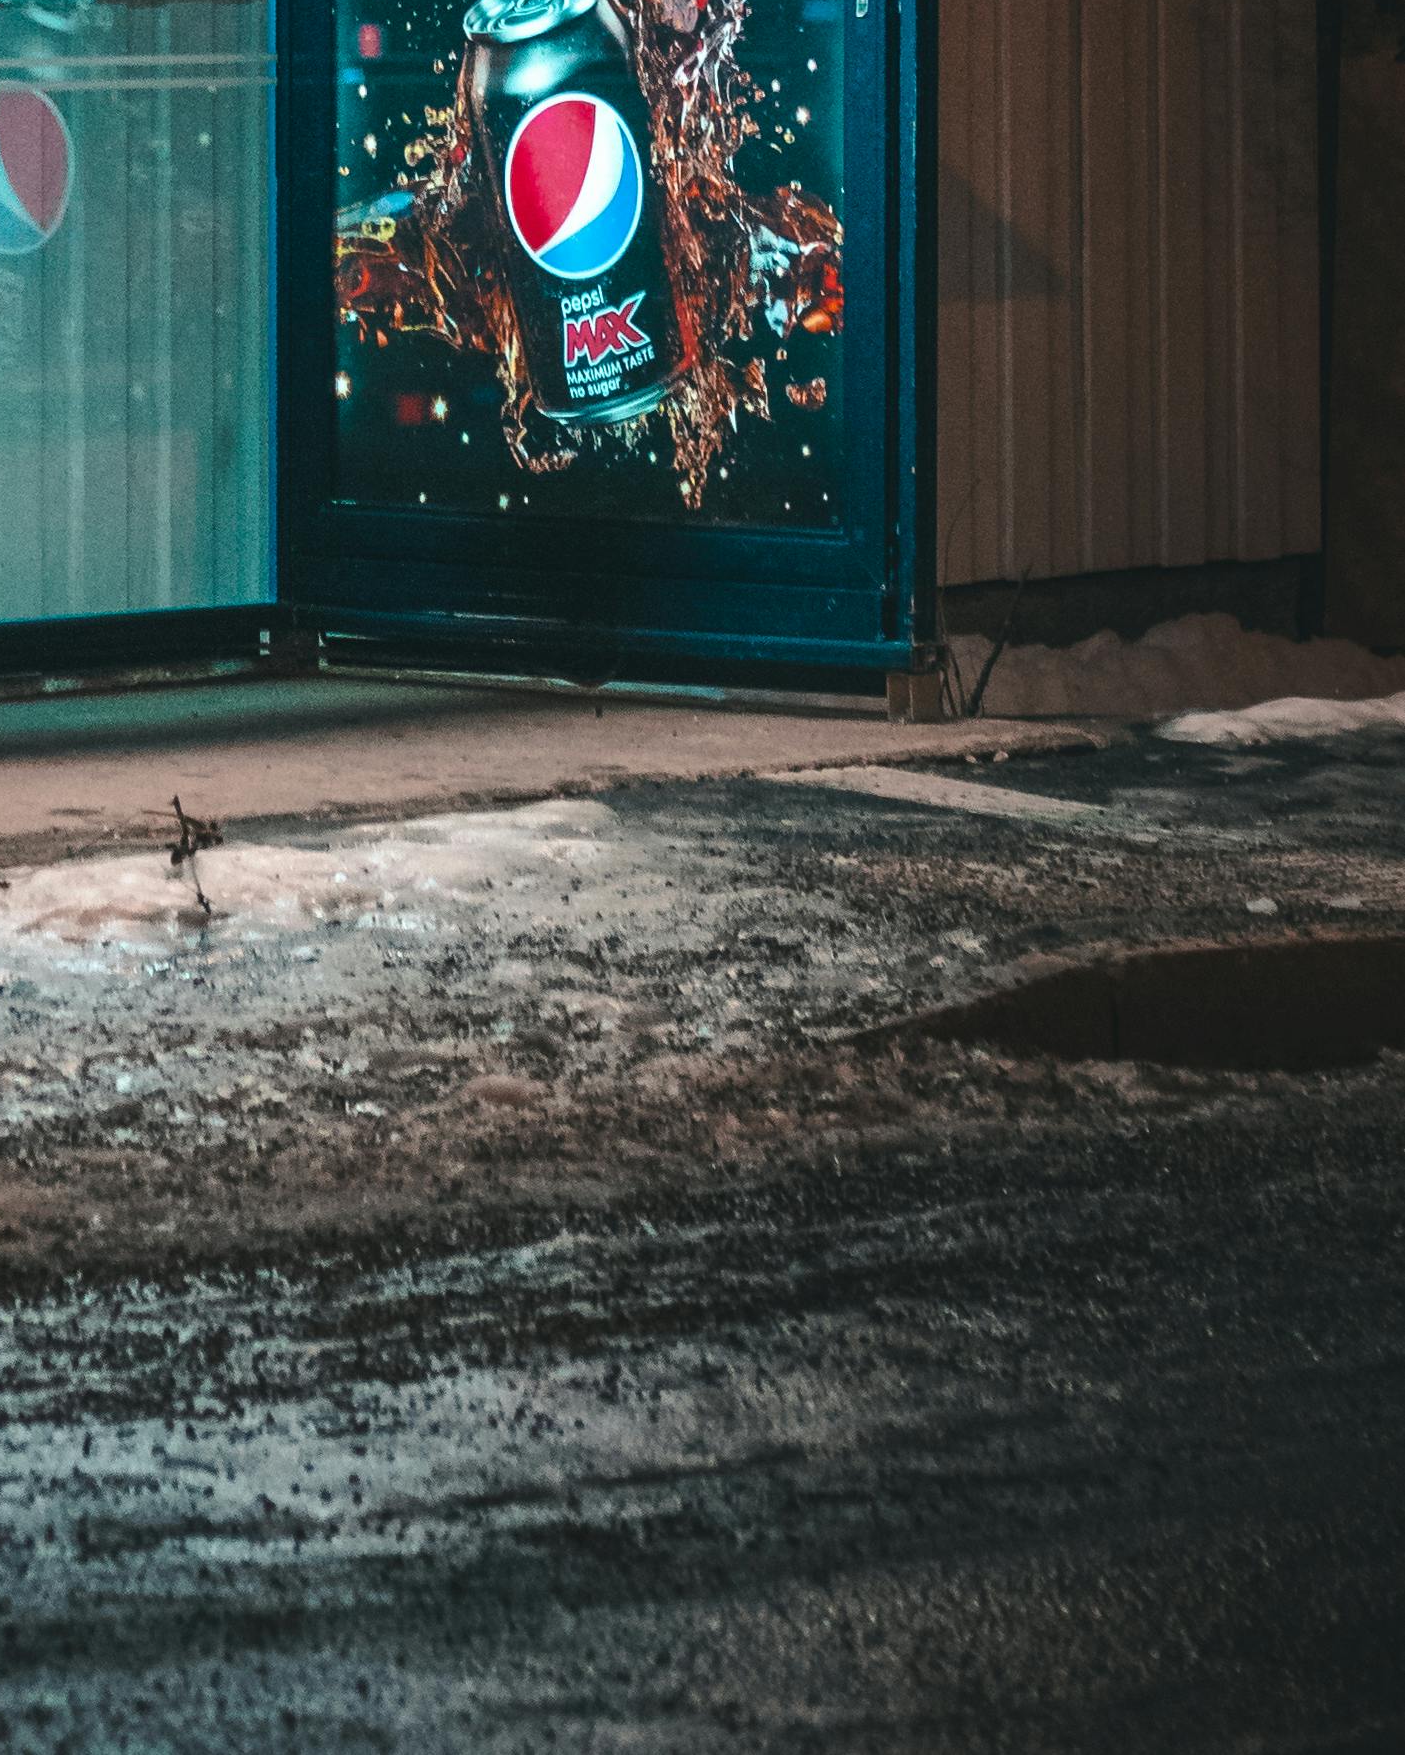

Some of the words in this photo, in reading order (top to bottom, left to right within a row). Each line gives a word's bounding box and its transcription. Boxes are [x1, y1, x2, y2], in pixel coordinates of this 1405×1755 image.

[561, 284, 605, 319] pepsi
[564, 290, 651, 368] MAX
[566, 360, 623, 385] MAXIMUM
[622, 344, 656, 371] TASTE
[569, 385, 586, 399] no
[587, 376, 622, 397] sugar
